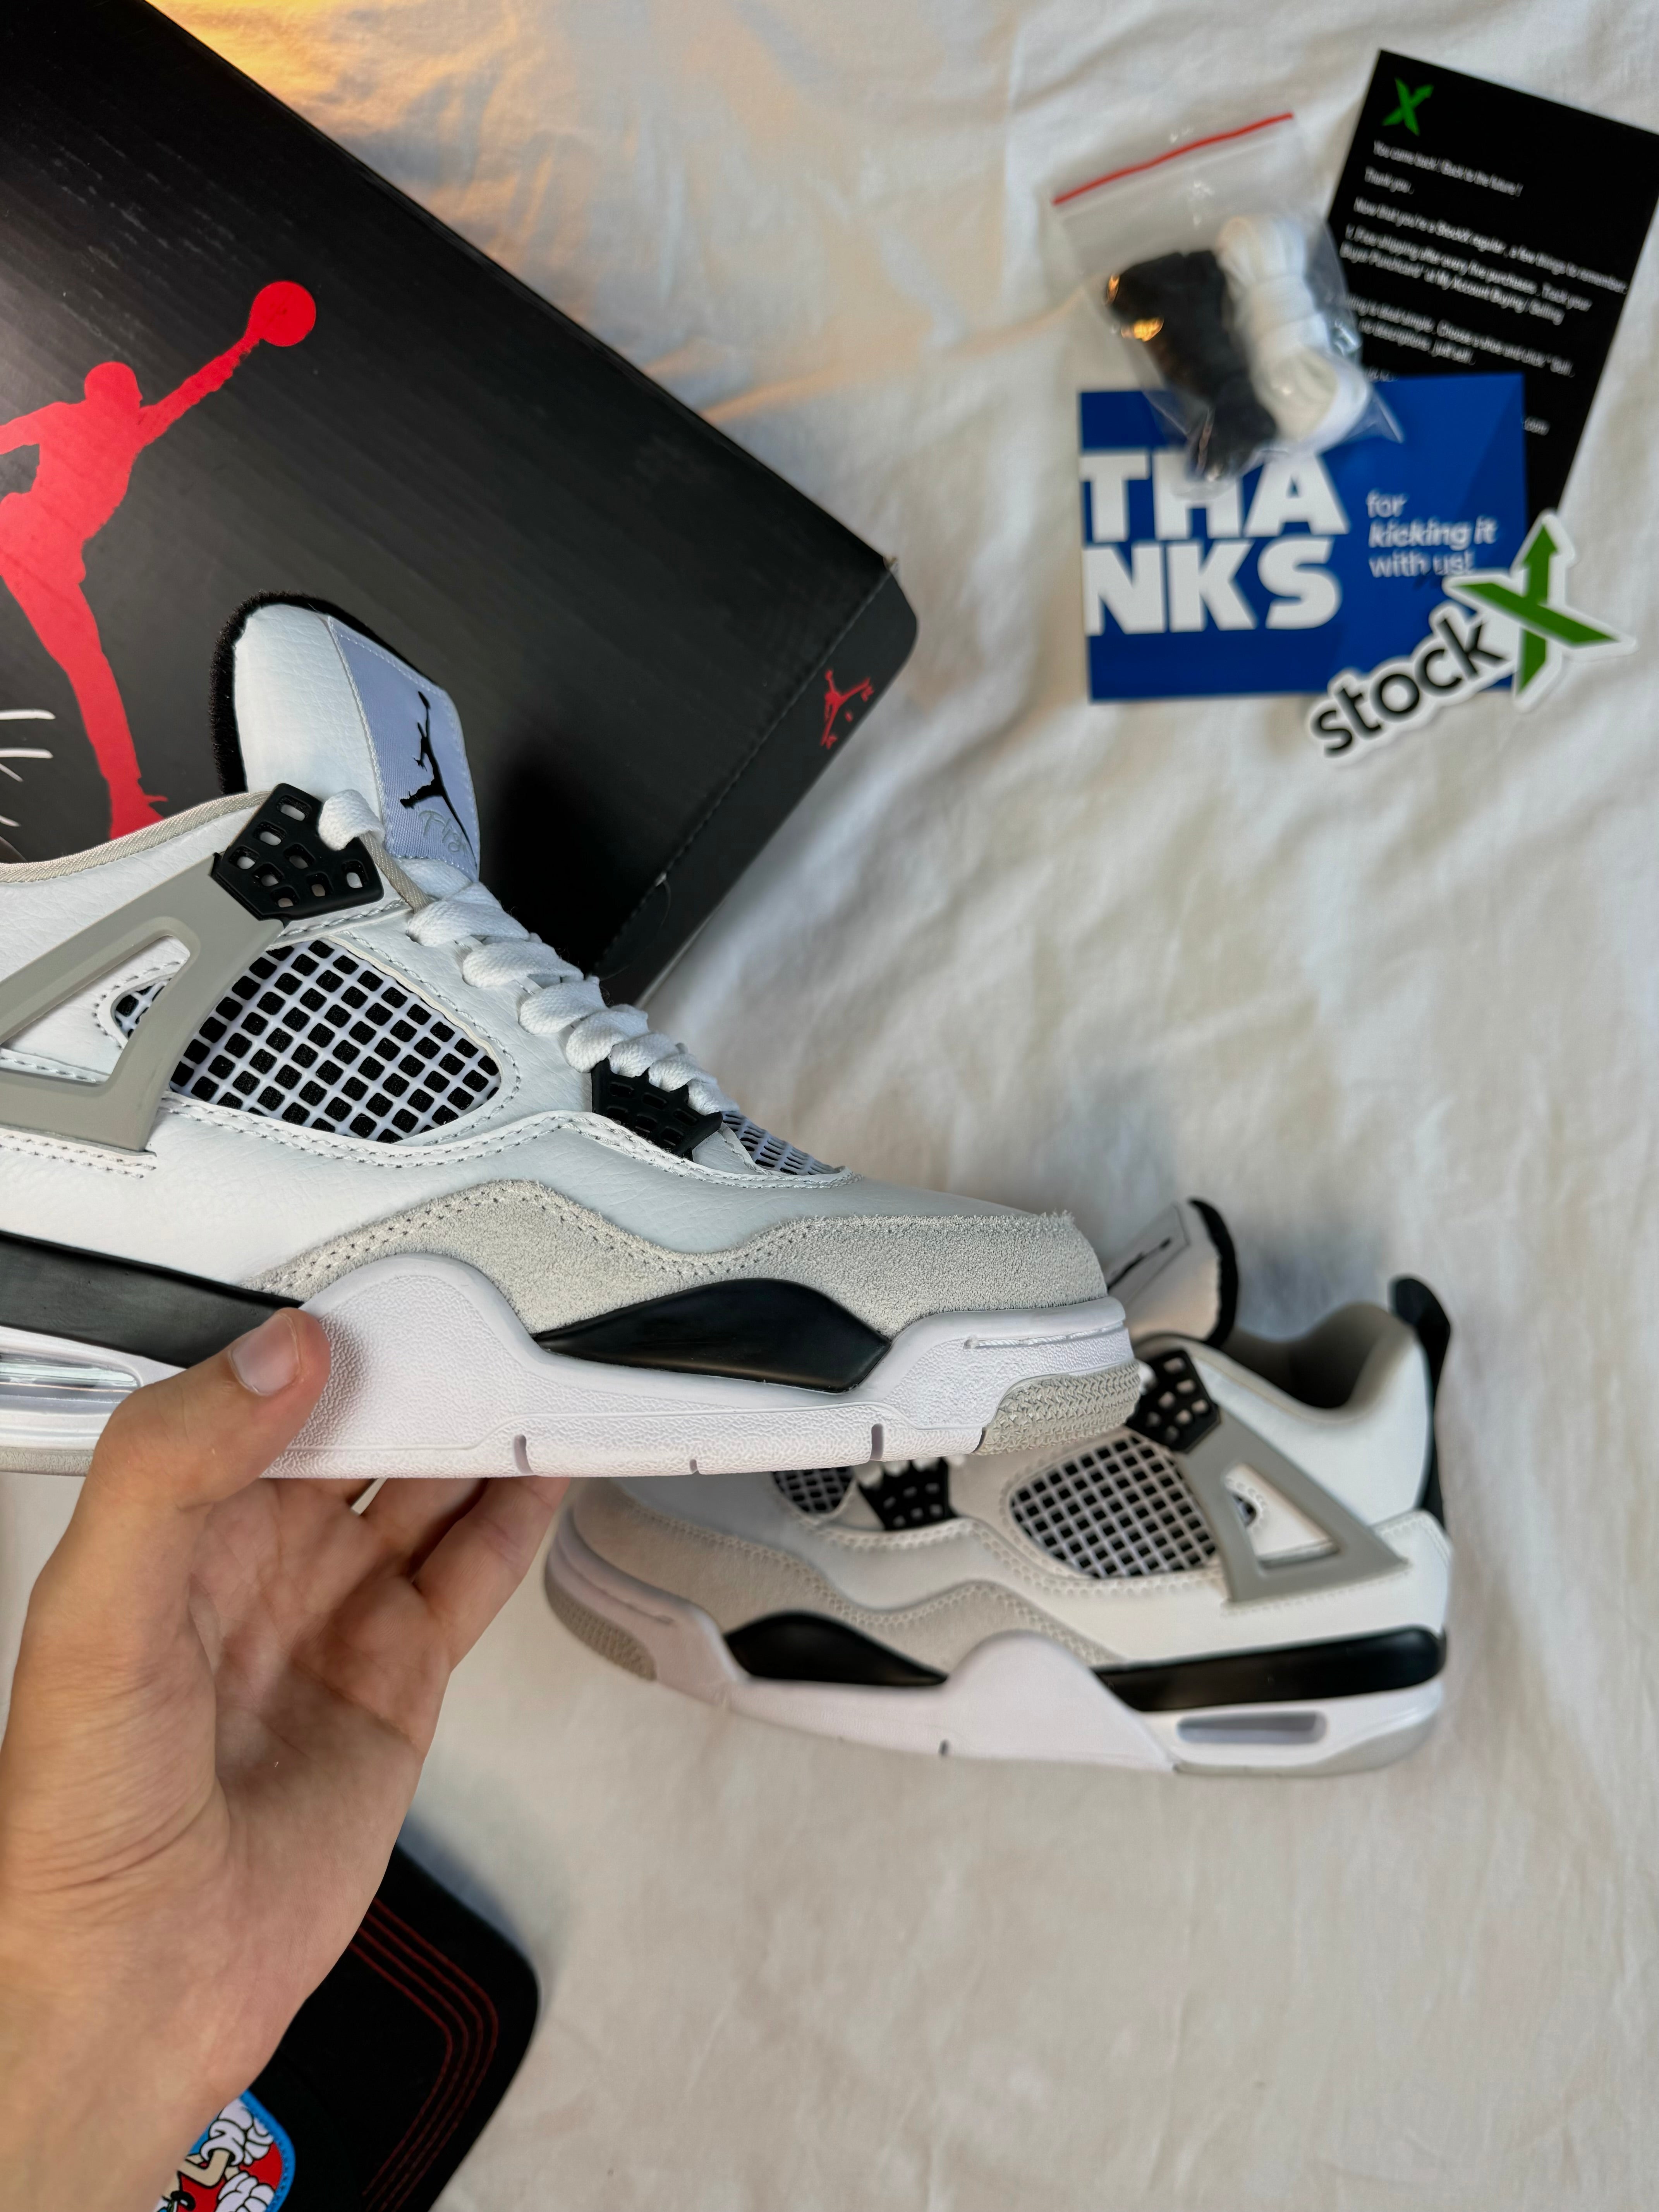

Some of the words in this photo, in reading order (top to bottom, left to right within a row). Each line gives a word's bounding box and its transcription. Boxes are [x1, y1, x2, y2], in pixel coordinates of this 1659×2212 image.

[1366, 489, 1407, 518] for
[1368, 518, 1472, 551] kicking
[1474, 515, 1498, 544] it
[1368, 549, 1431, 578] with
[1432, 550, 1475, 576] us!
[1083, 533, 1342, 636] NKS
